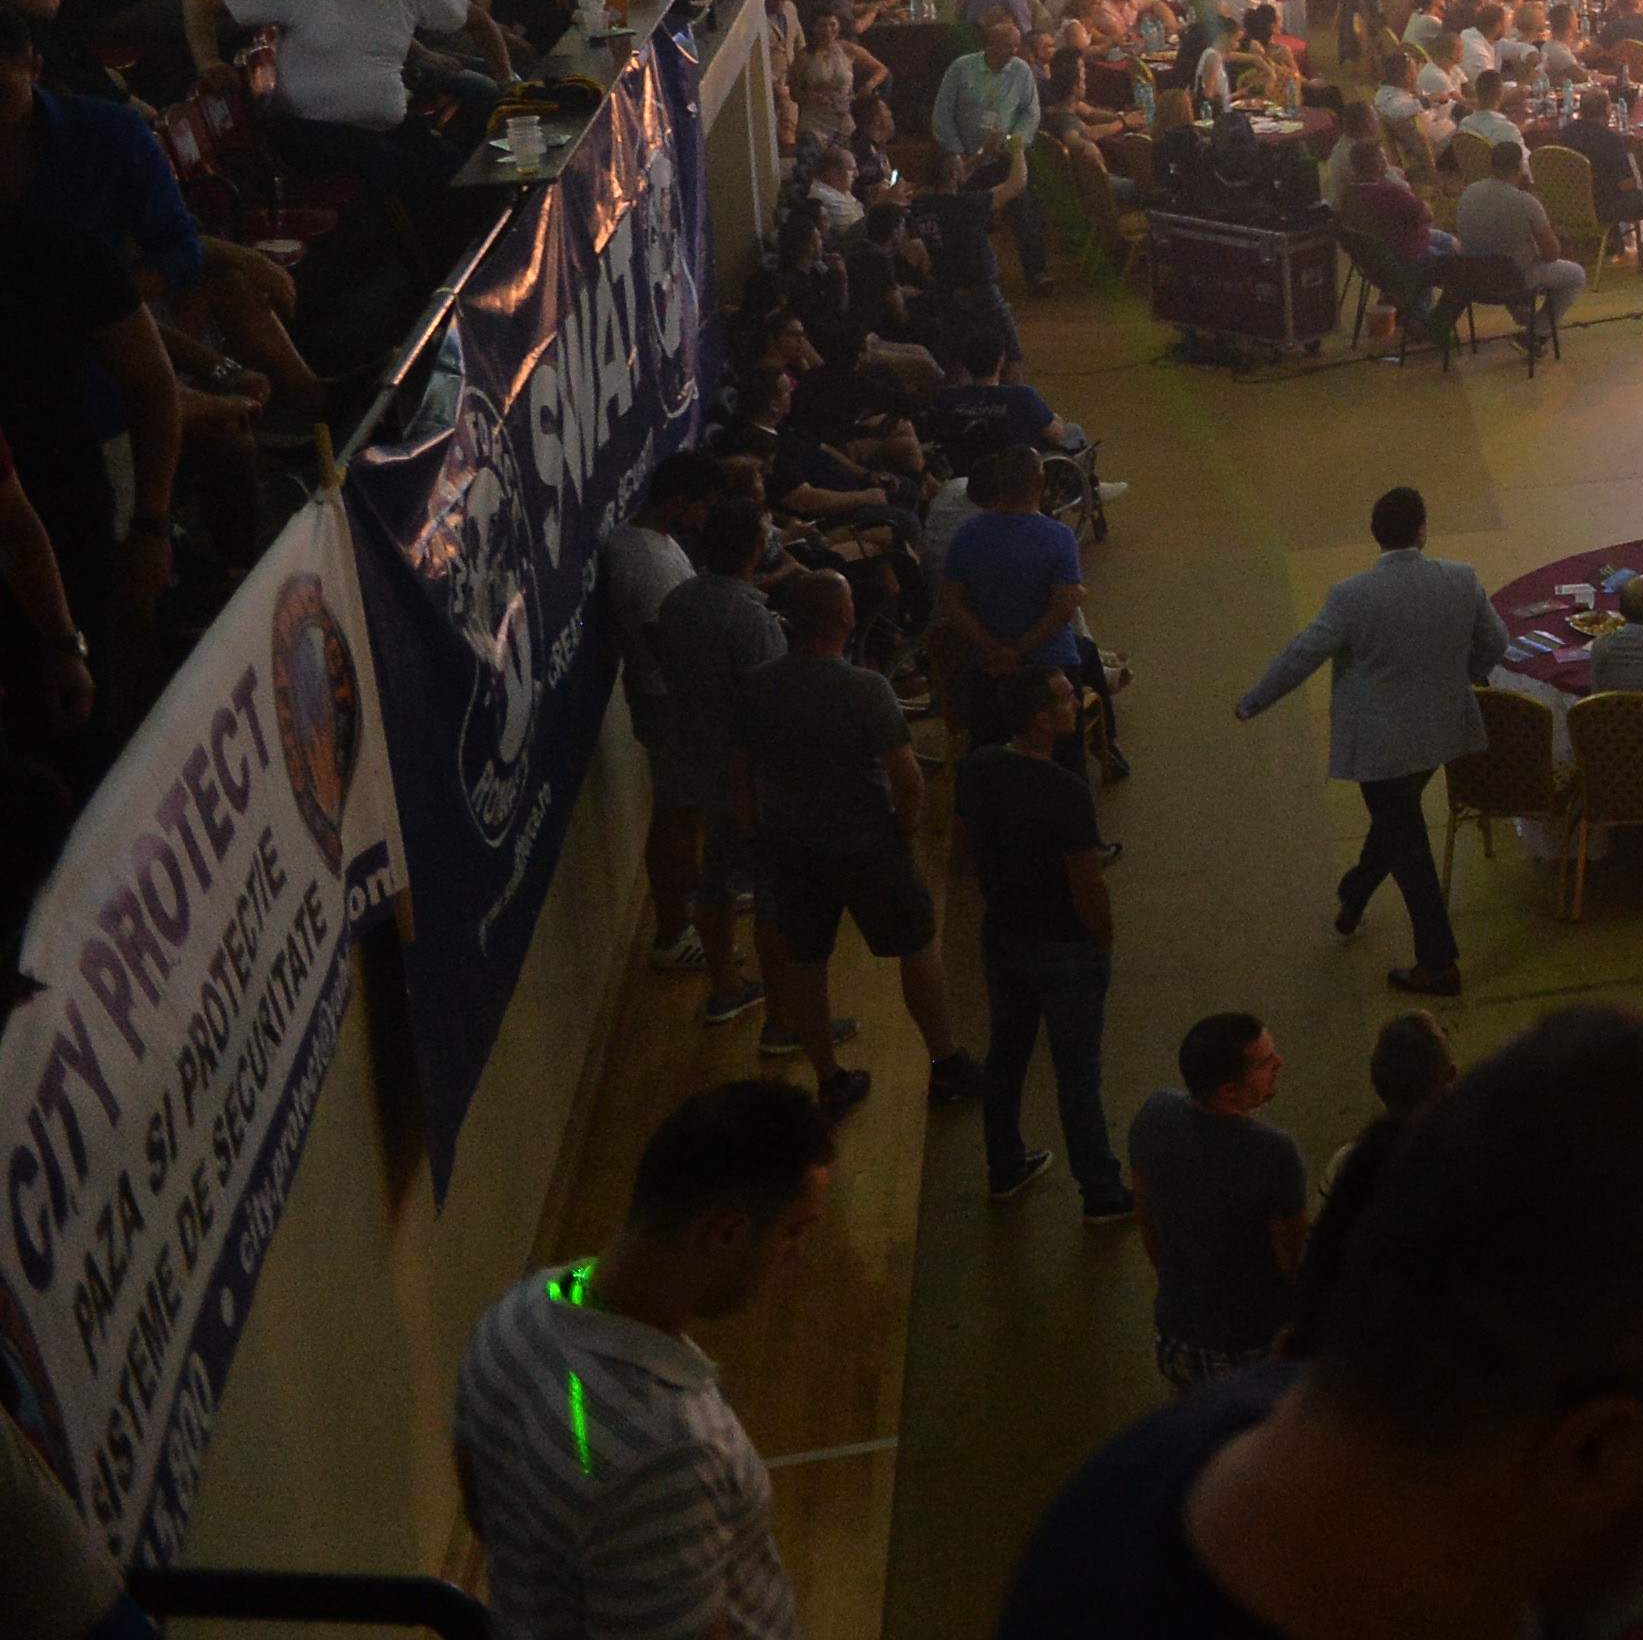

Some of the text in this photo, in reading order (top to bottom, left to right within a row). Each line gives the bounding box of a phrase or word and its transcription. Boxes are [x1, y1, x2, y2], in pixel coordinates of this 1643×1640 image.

[8, 665, 272, 1291] CITY PROTECT
[73, 824, 288, 1380] PAZA SI PROTECTIE
[174, 1156, 216, 1278] DE
[211, 877, 329, 1189] SECURITATE
